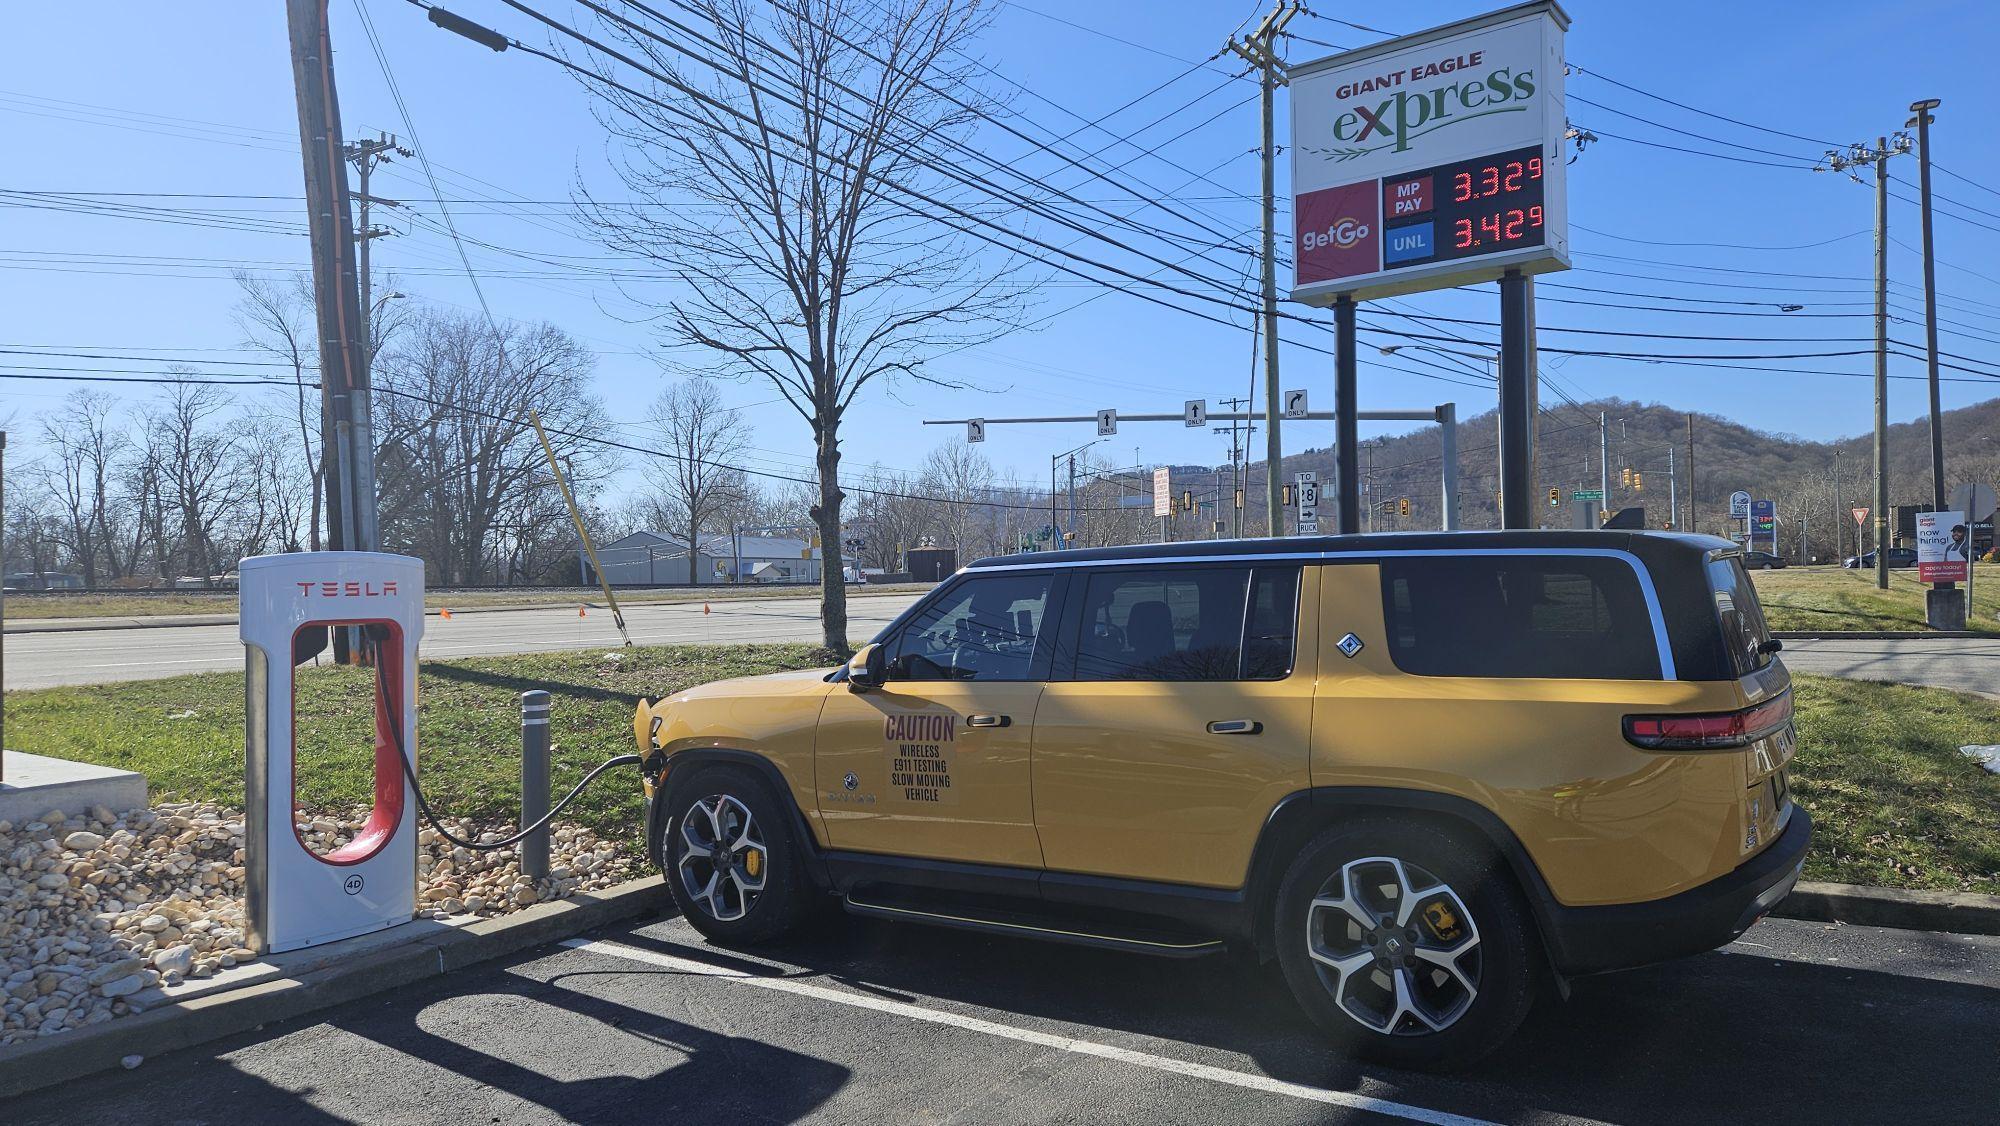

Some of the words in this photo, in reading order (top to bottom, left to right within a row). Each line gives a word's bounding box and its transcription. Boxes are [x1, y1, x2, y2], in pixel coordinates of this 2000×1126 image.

[1336, 70, 1406, 100] GIANT
[1411, 50, 1483, 82] EAGLE
[1397, 182, 1421, 198] MP
[1395, 197, 1423, 214] PAY
[1302, 222, 1369, 251] getGo
[1394, 234, 1426, 251] UNL
[1288, 409, 1305, 417] ONLY
[1187, 418, 1203, 426] ONLY
[1300, 473, 1312, 481] TO
[1920, 536, 1949, 545] hiring!
[296, 582, 398, 597] TESLA
[886, 715, 955, 742] CAUTION
[900, 744, 940, 758] WIRELESS
[894, 758, 912, 772] E911
[914, 759, 947, 773] TESTING
[892, 772, 914, 786] SLOW
[916, 773, 950, 788] MOVING
[905, 787, 939, 802] VEHICLE
[346, 880, 362, 889] 4D
